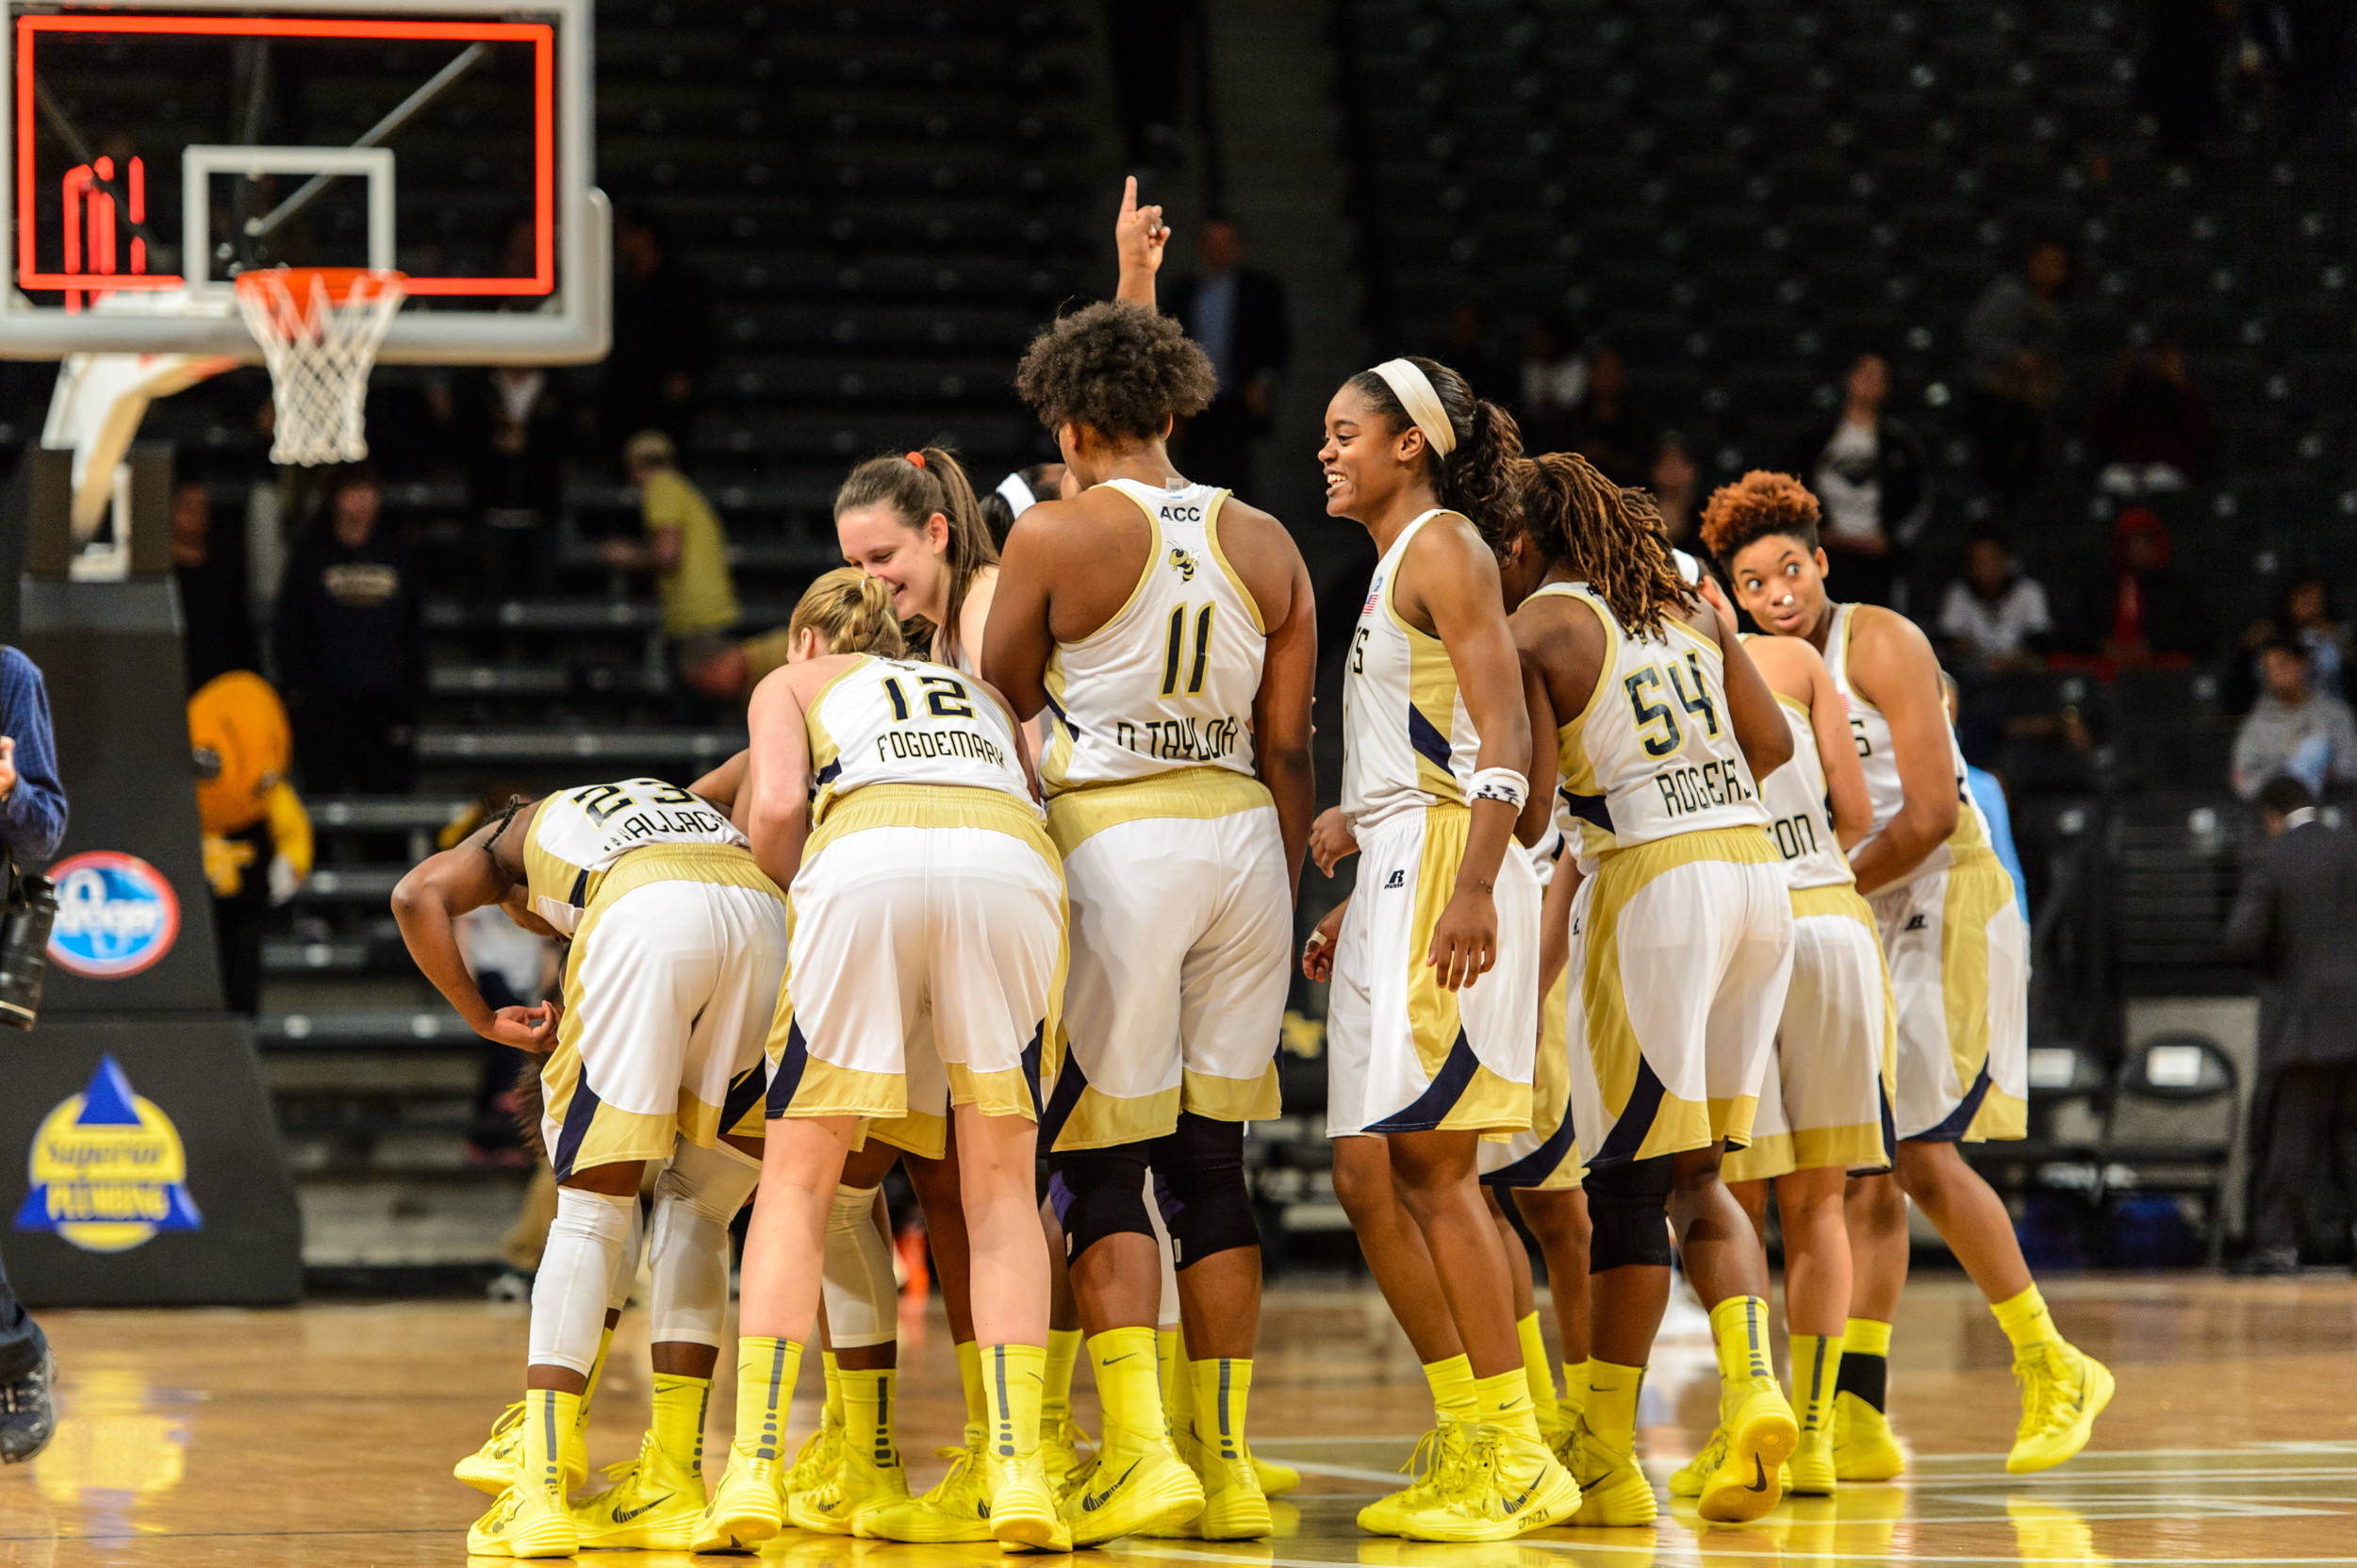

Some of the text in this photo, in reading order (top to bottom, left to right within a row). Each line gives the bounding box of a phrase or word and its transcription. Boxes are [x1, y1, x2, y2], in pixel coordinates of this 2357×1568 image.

[1160, 505, 1201, 523] ACC
[1159, 601, 1215, 700] 11
[881, 676, 979, 723] 12
[1623, 649, 1722, 761] 54
[1145, 716, 1239, 761] TAYLOR
[569, 781, 700, 833] 23
[1655, 758, 1754, 817] ROGER
[48, 1138, 167, 1170] Superior
[45, 1179, 170, 1221] PLUMBING
